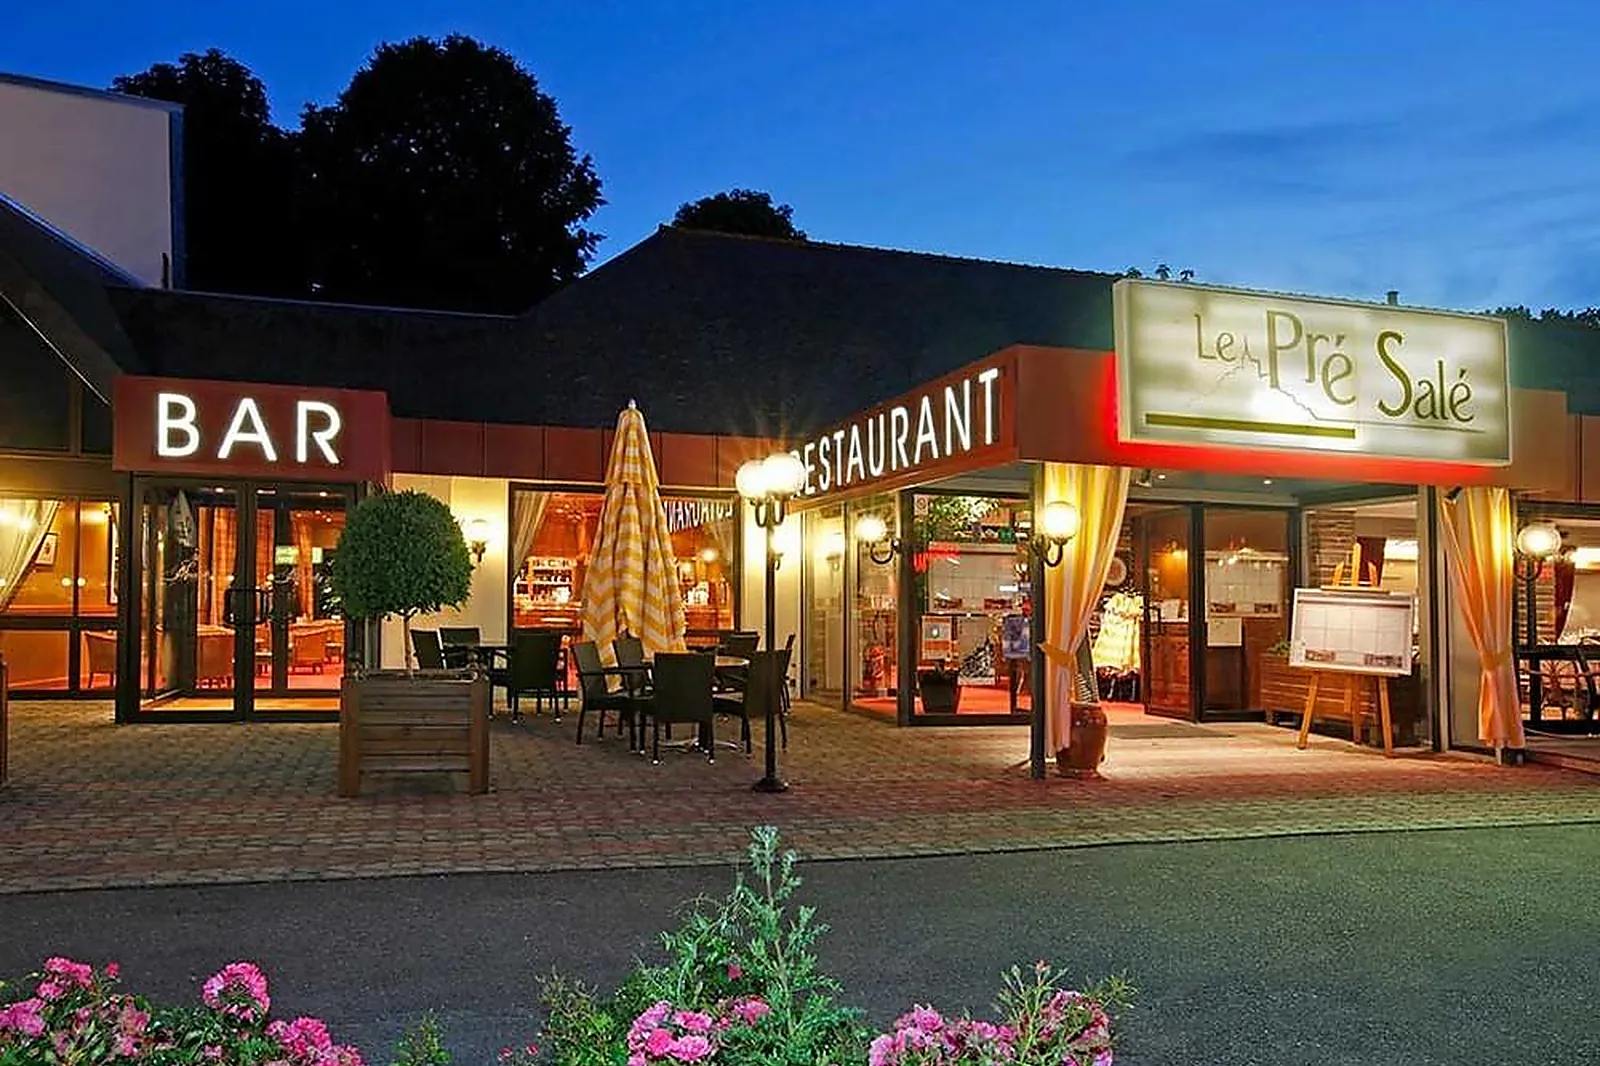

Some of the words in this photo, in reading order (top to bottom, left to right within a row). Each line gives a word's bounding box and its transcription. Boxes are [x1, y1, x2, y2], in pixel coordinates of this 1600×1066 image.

[1194, 313, 1236, 363] Le
[1265, 309, 1357, 405] Pré
[1377, 330, 1475, 424] Salé
[158, 393, 342, 464] BAR
